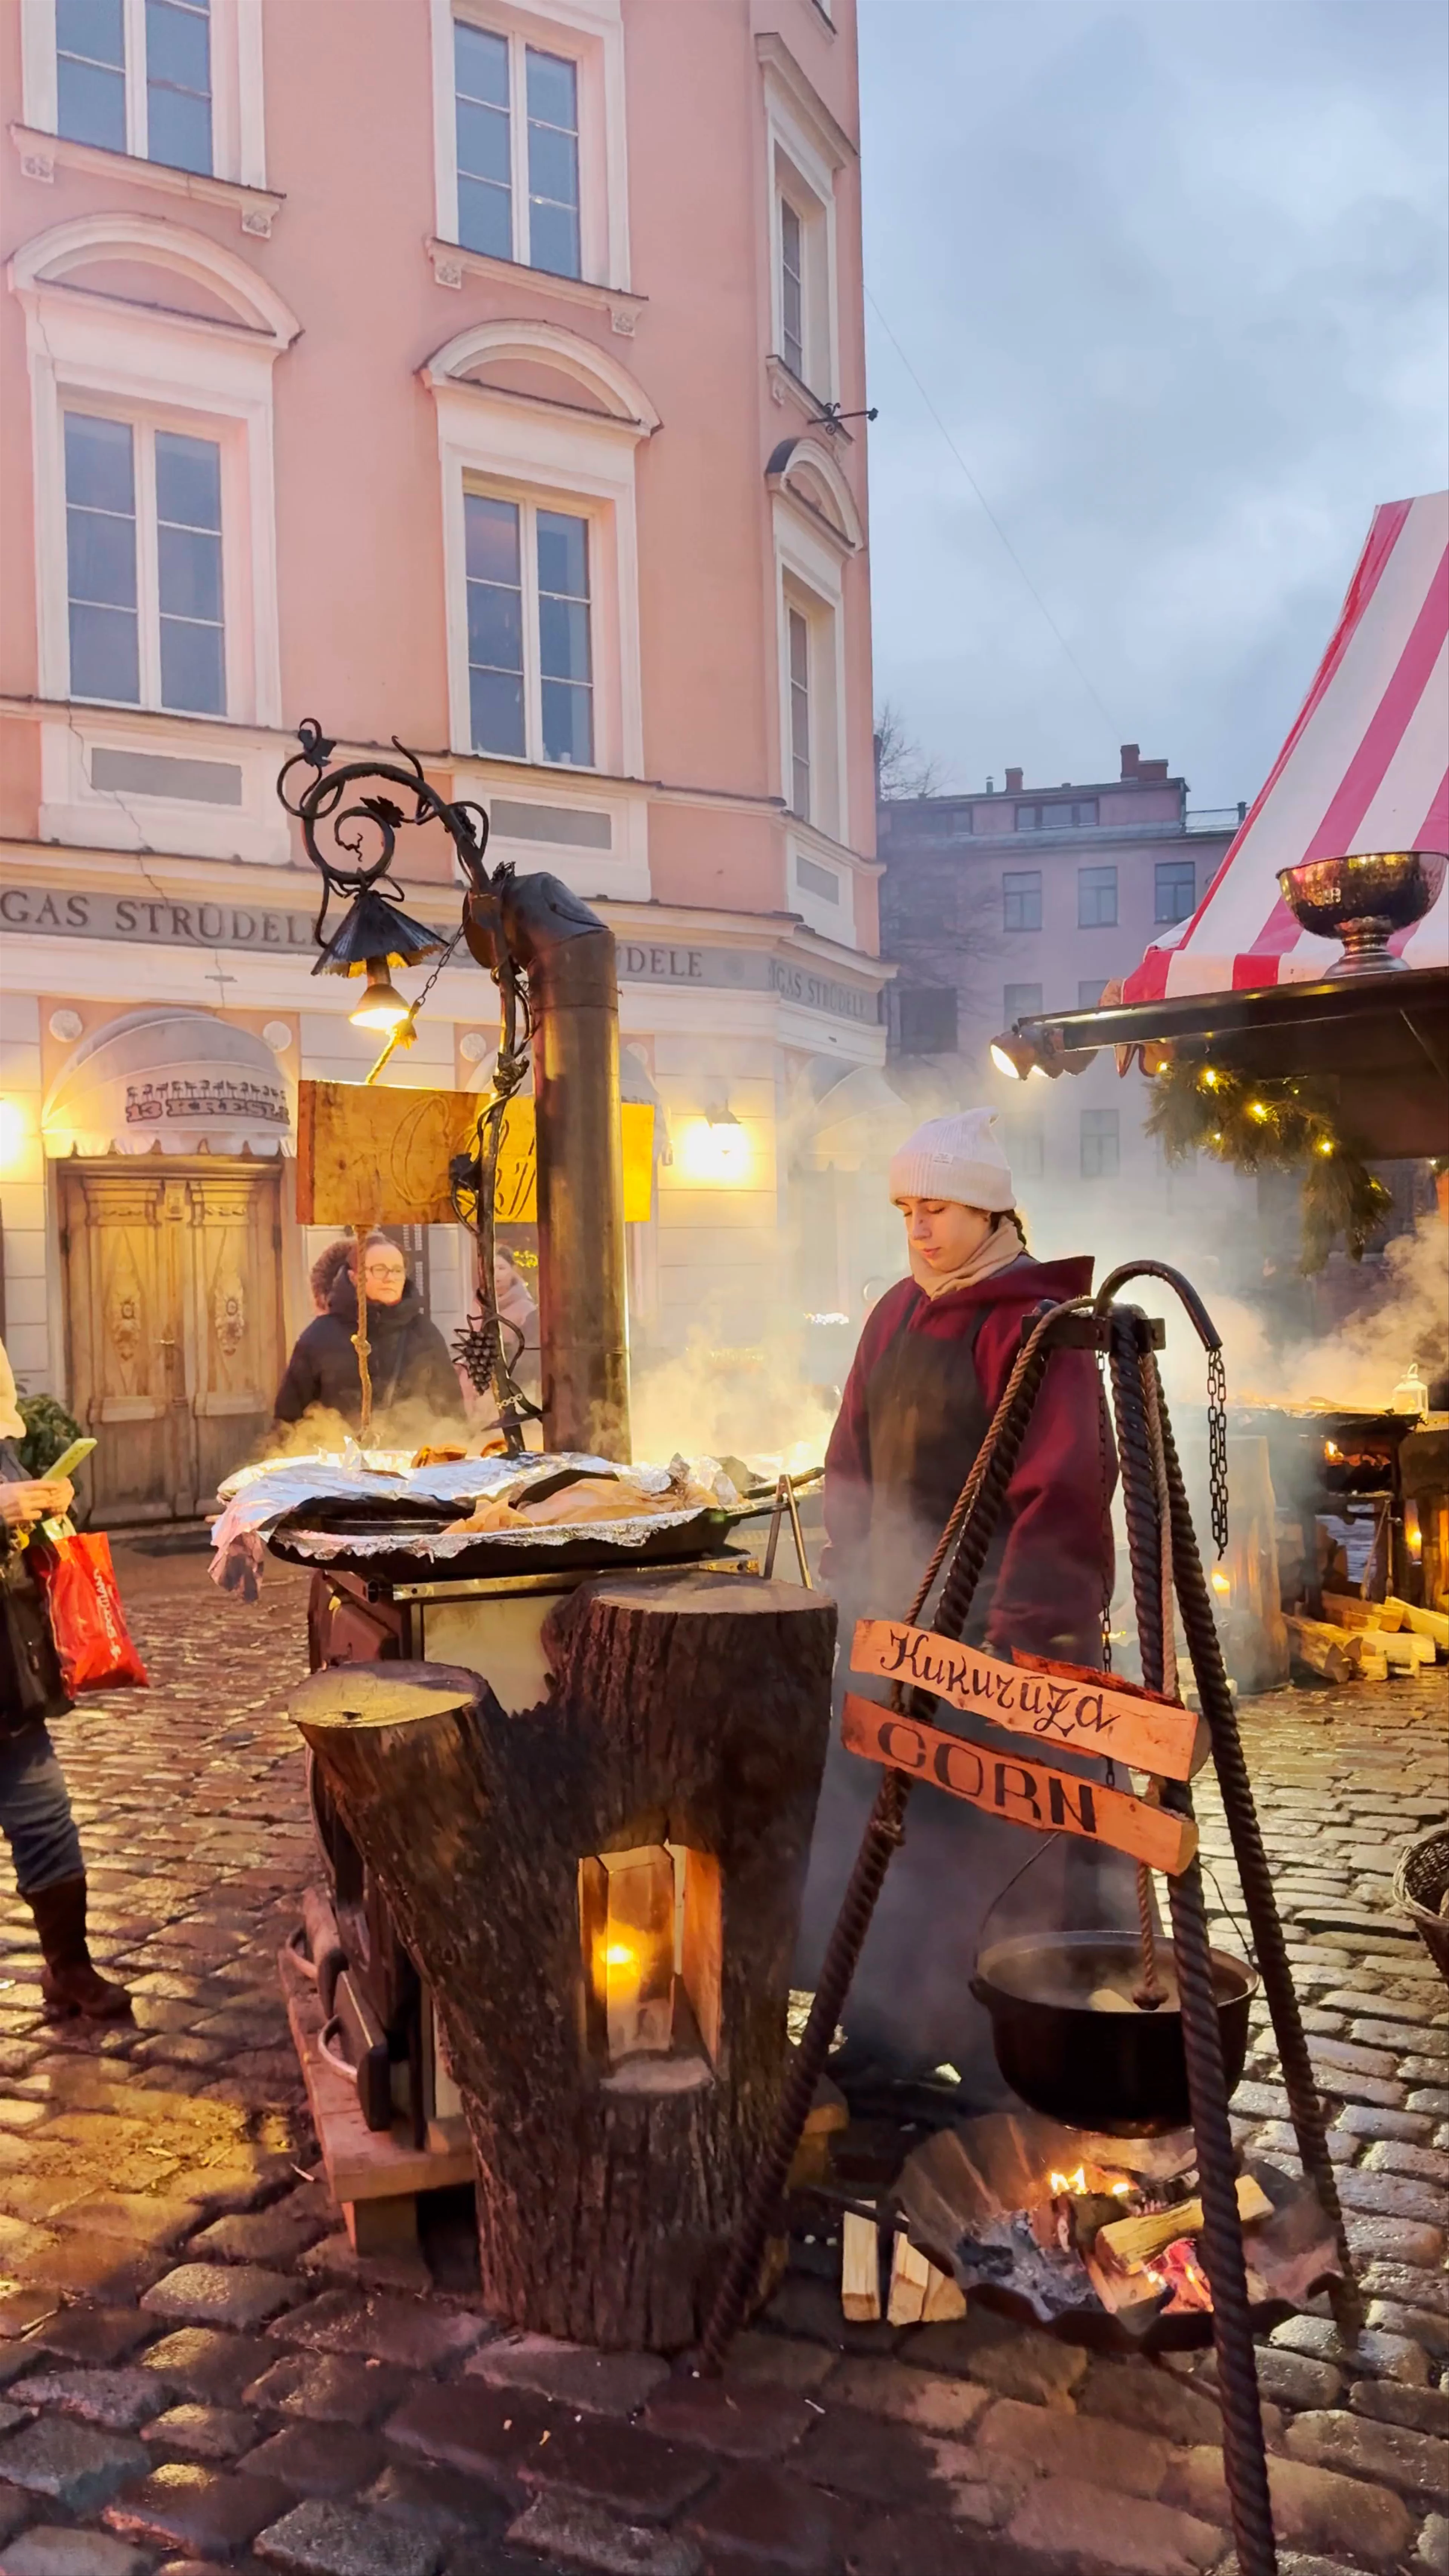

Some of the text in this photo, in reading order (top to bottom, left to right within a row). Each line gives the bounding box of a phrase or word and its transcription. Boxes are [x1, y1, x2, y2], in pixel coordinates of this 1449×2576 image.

[615, 946, 703, 977] DELE
[126, 1100, 163, 1123] 13
[880, 1629, 1121, 1737] Kukurūza
[878, 1722, 1097, 1834] CORN
